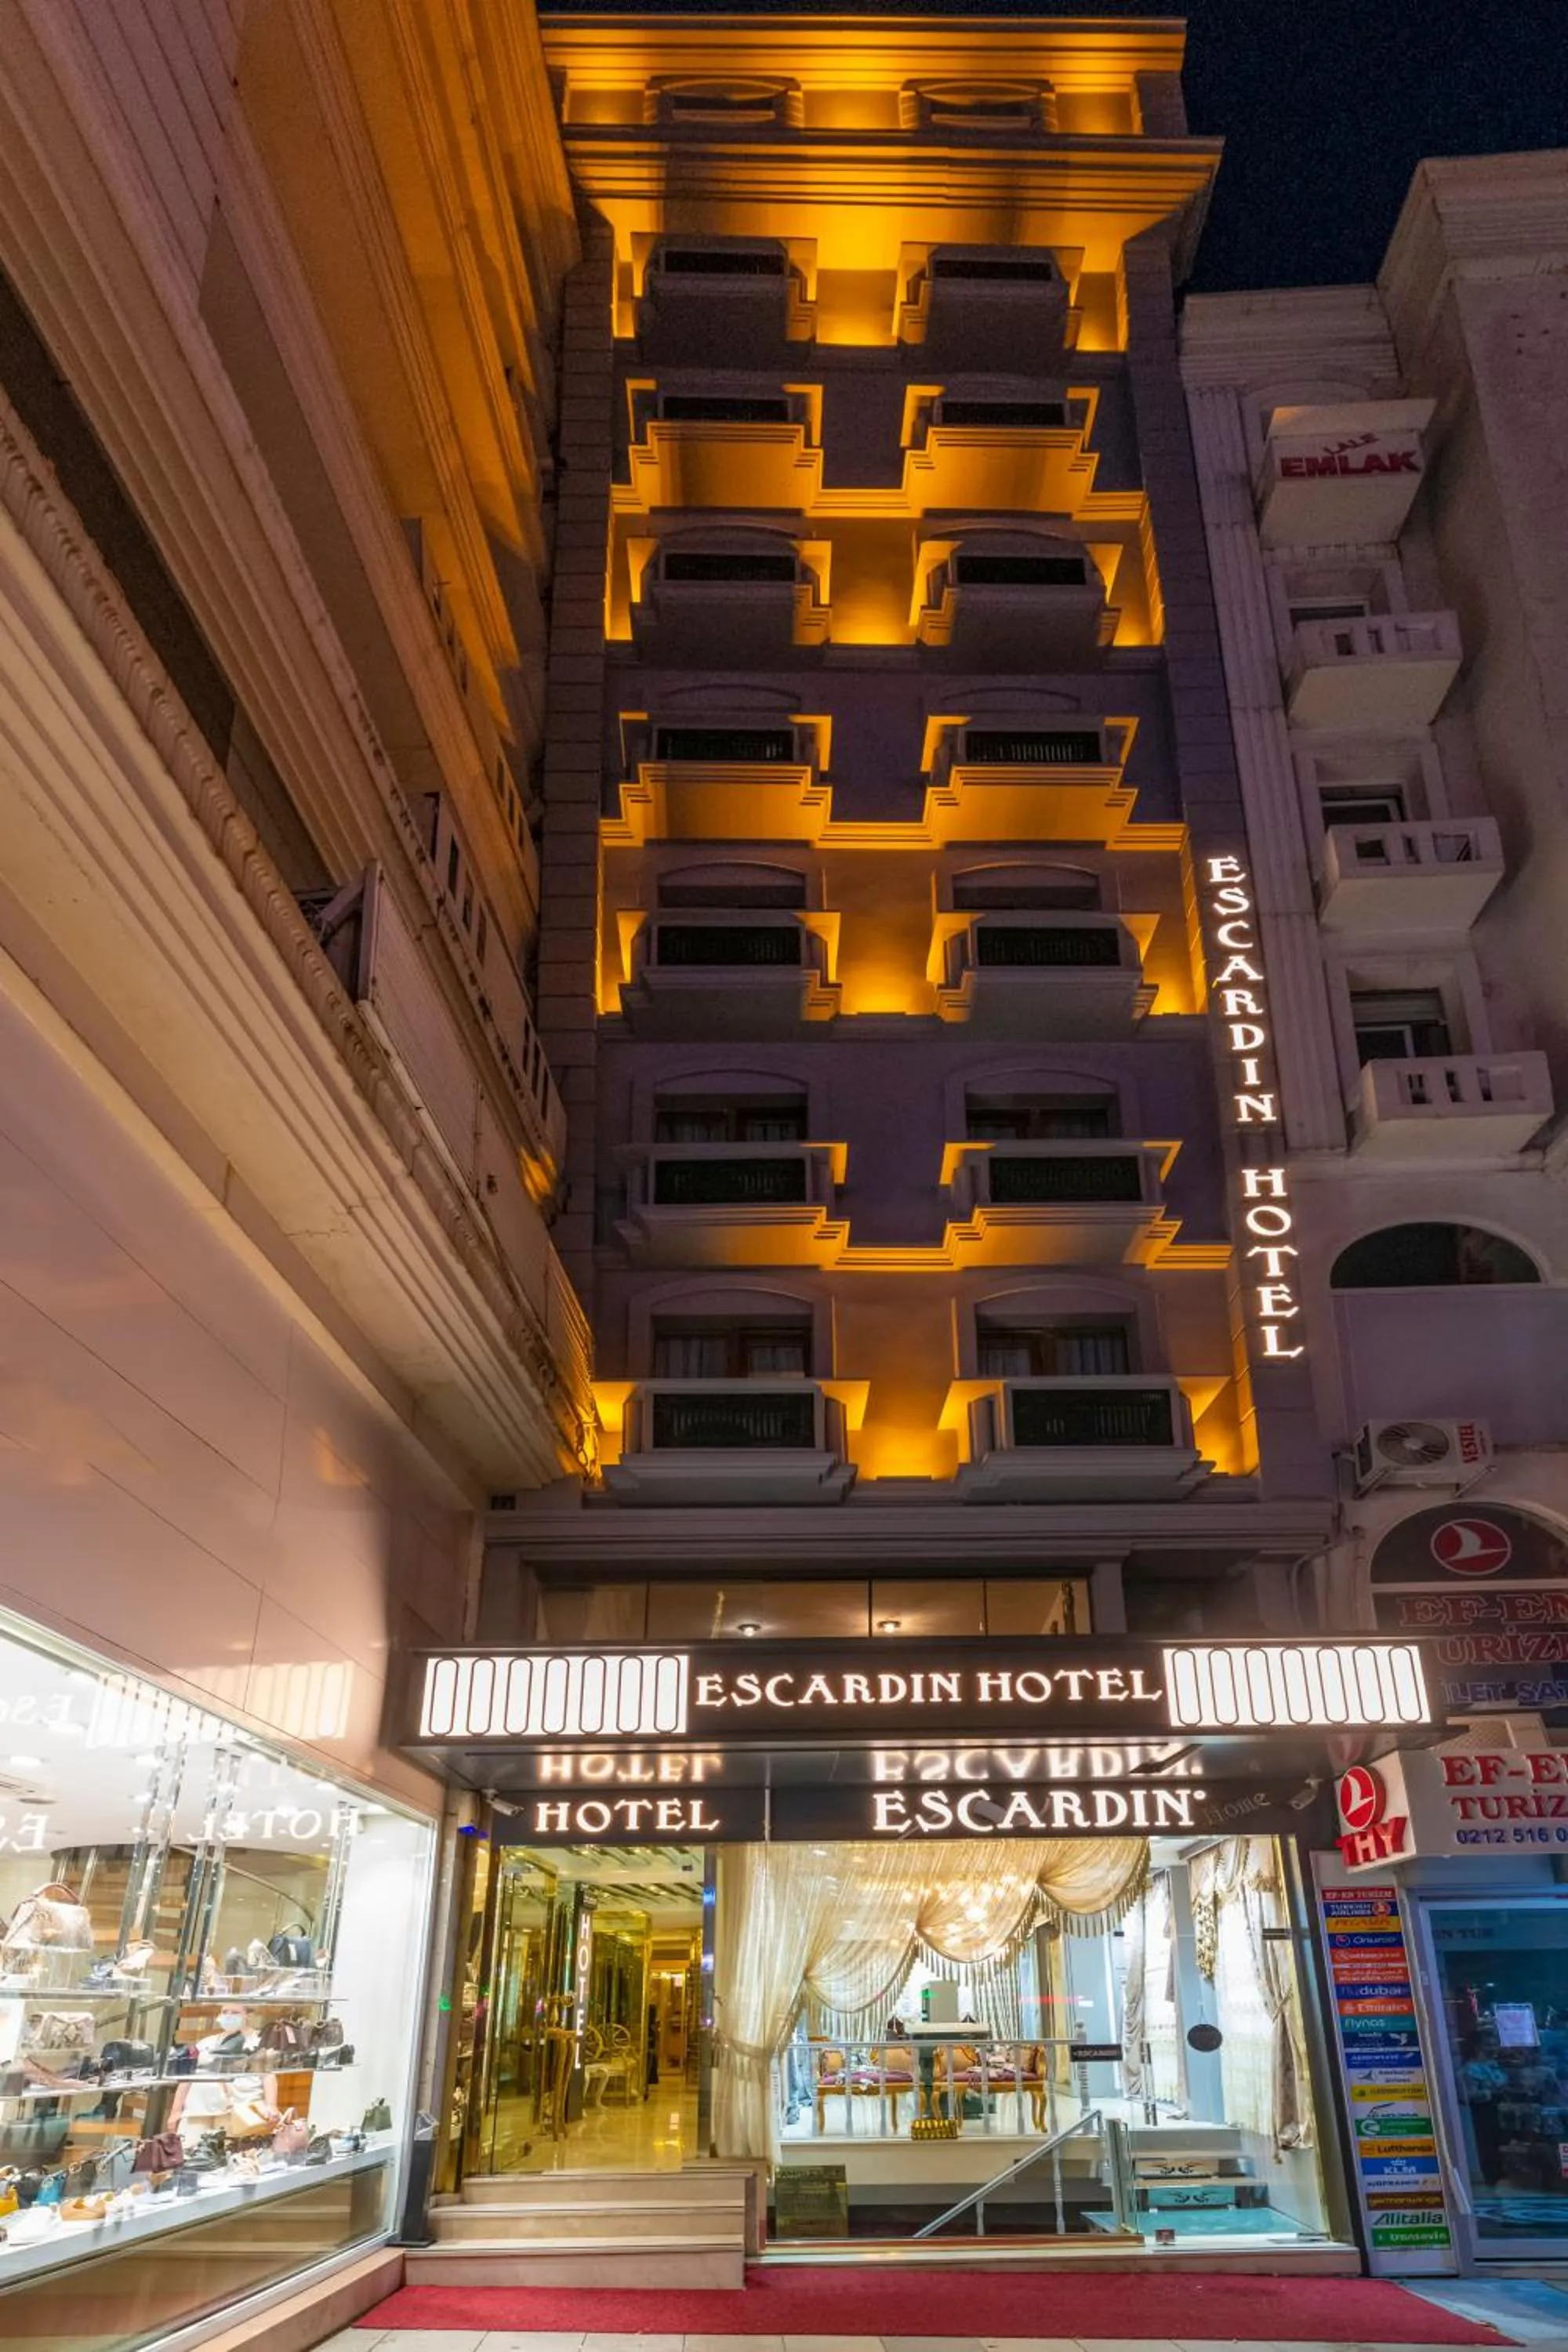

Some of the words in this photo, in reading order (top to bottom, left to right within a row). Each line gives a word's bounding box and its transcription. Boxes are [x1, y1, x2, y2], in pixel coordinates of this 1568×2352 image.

[1280, 450, 1421, 477] EMLAK
[1207, 855, 1277, 1122] ESCARDIN
[1241, 1168, 1304, 1358] HOTEL
[1456, 1422, 1479, 1464] VESTEL
[695, 1673, 962, 1708] ESCARDIN
[977, 1668, 1163, 1704] HOTEL
[1440, 1754, 1568, 1786] EF-E
[535, 1798, 720, 1832] HOTEL
[873, 1788, 1196, 1832] ESCARDIN
[1334, 1816, 1407, 1866] THY
[1456, 1828, 1505, 1844] 0212
[1512, 1827, 1549, 1843] 516
[1555, 1827, 1568, 1842] 0
[574, 1913, 590, 2070] HOTEL
[1377, 2144, 1432, 2154] Lufthansa
[1383, 2165, 1417, 2174] KLM
[1372, 2211, 1443, 2225] Alitalia
